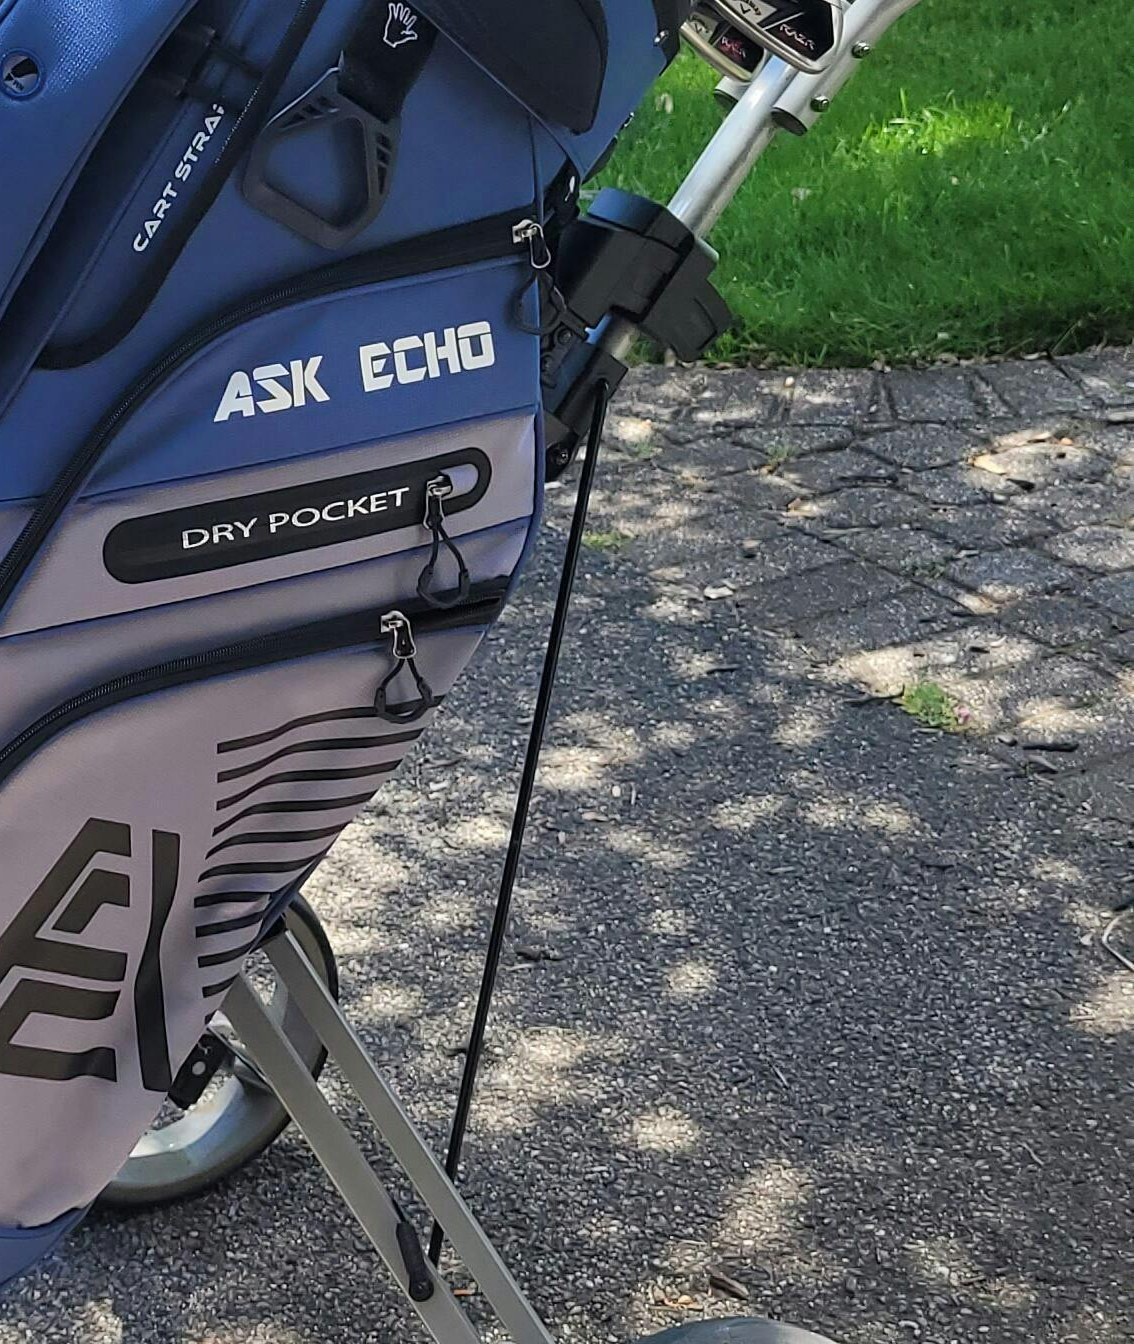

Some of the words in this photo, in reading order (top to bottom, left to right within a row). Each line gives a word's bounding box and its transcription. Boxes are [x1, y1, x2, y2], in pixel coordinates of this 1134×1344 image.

[779, 23, 816, 51] RAZR
[133, 181, 178, 252] CART
[213, 355, 331, 422] ASK
[359, 320, 495, 393] ECHO
[181, 517, 258, 550] DRY
[268, 487, 410, 534] POCKET
